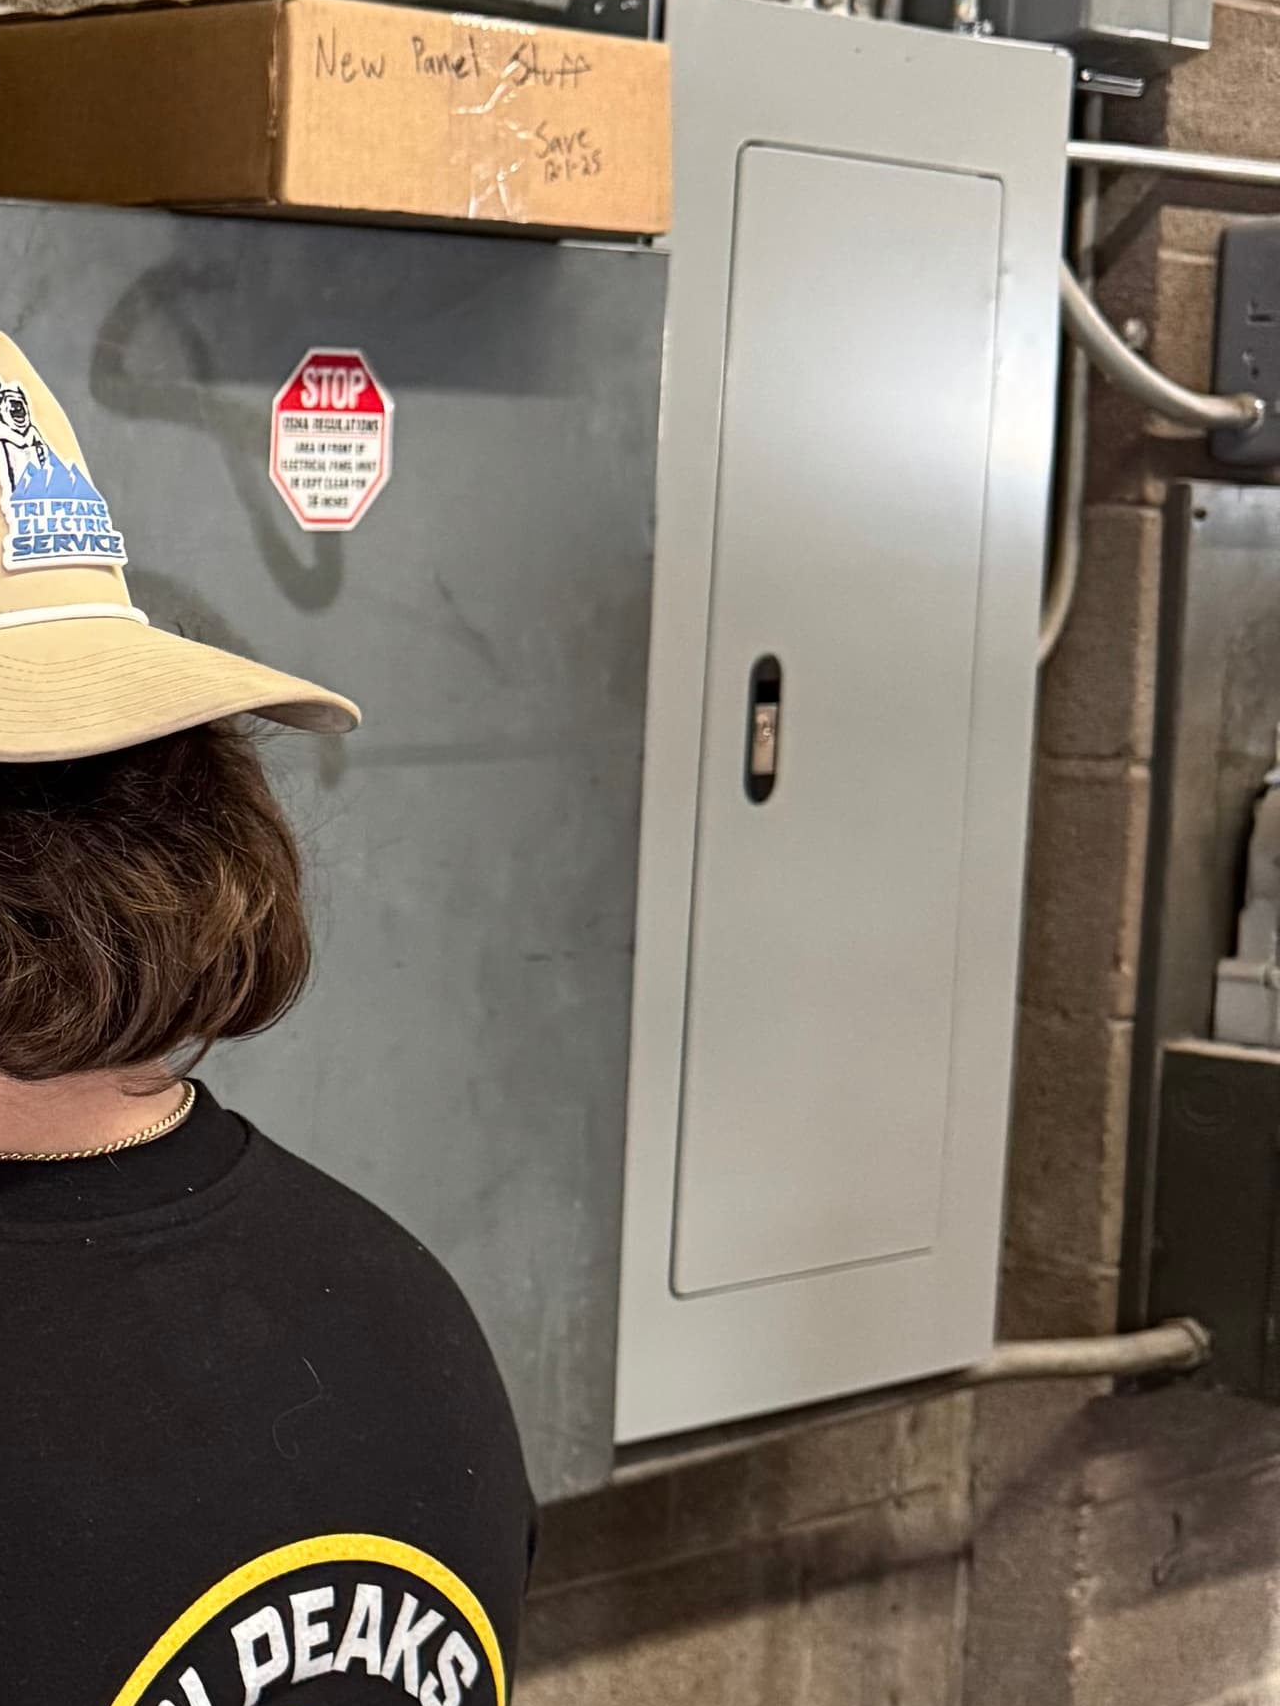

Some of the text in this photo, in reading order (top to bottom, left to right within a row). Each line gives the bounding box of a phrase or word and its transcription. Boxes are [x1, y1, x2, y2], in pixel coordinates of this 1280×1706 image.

[315, 28, 592, 89] New Panel Stuff
[534, 120, 592, 160] Save
[300, 366, 368, 410] STOP
[312, 417, 379, 432] REGULATIONS
[10, 501, 107, 518] TRI PEAKS
[17, 517, 112, 535] ELECTRIC
[11, 533, 123, 557] SERVICE
